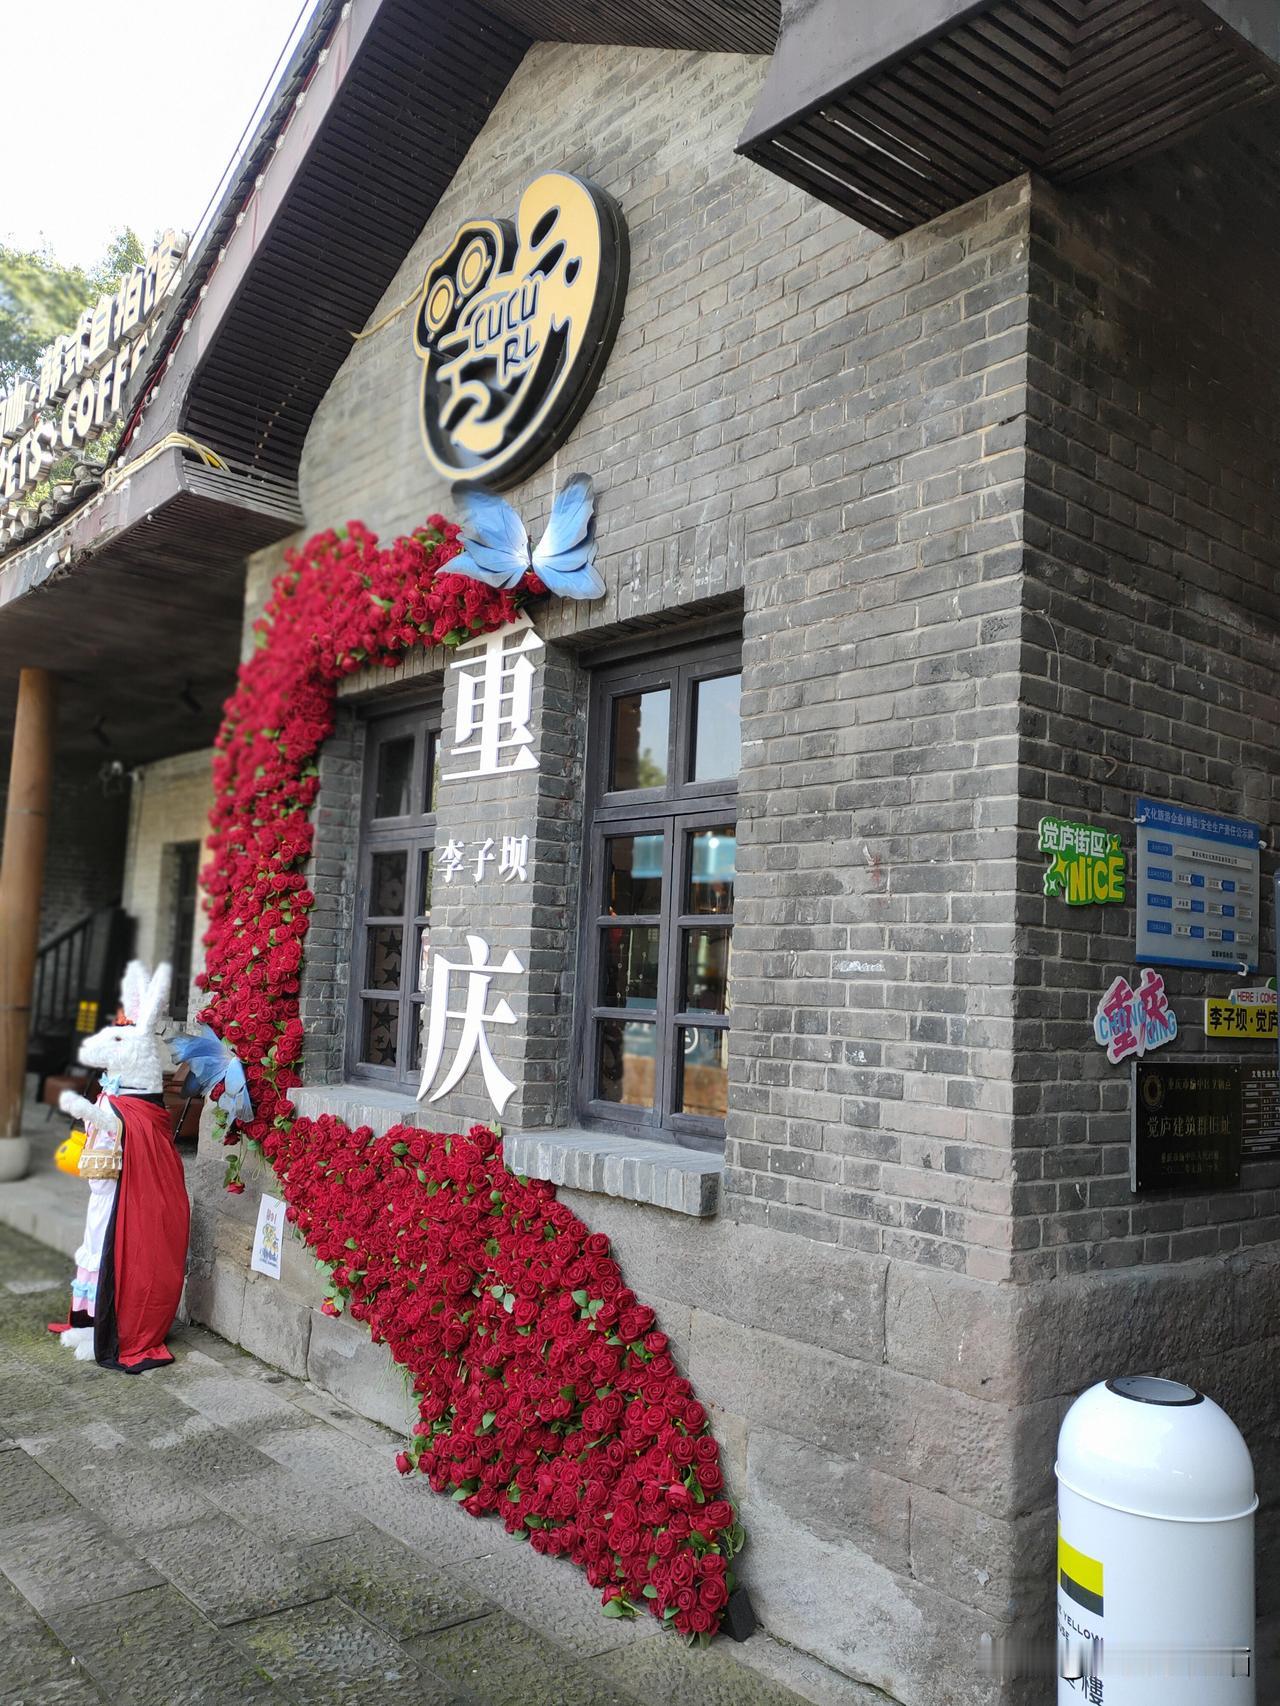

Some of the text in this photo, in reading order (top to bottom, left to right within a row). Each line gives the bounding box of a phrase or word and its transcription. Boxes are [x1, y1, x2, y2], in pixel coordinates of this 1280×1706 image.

[437, 834, 532, 884] 李子坝
[1043, 822, 1105, 859] 觉庐街区
[1237, 991, 1254, 1003] HERE
[1260, 992, 1277, 1004] COME
